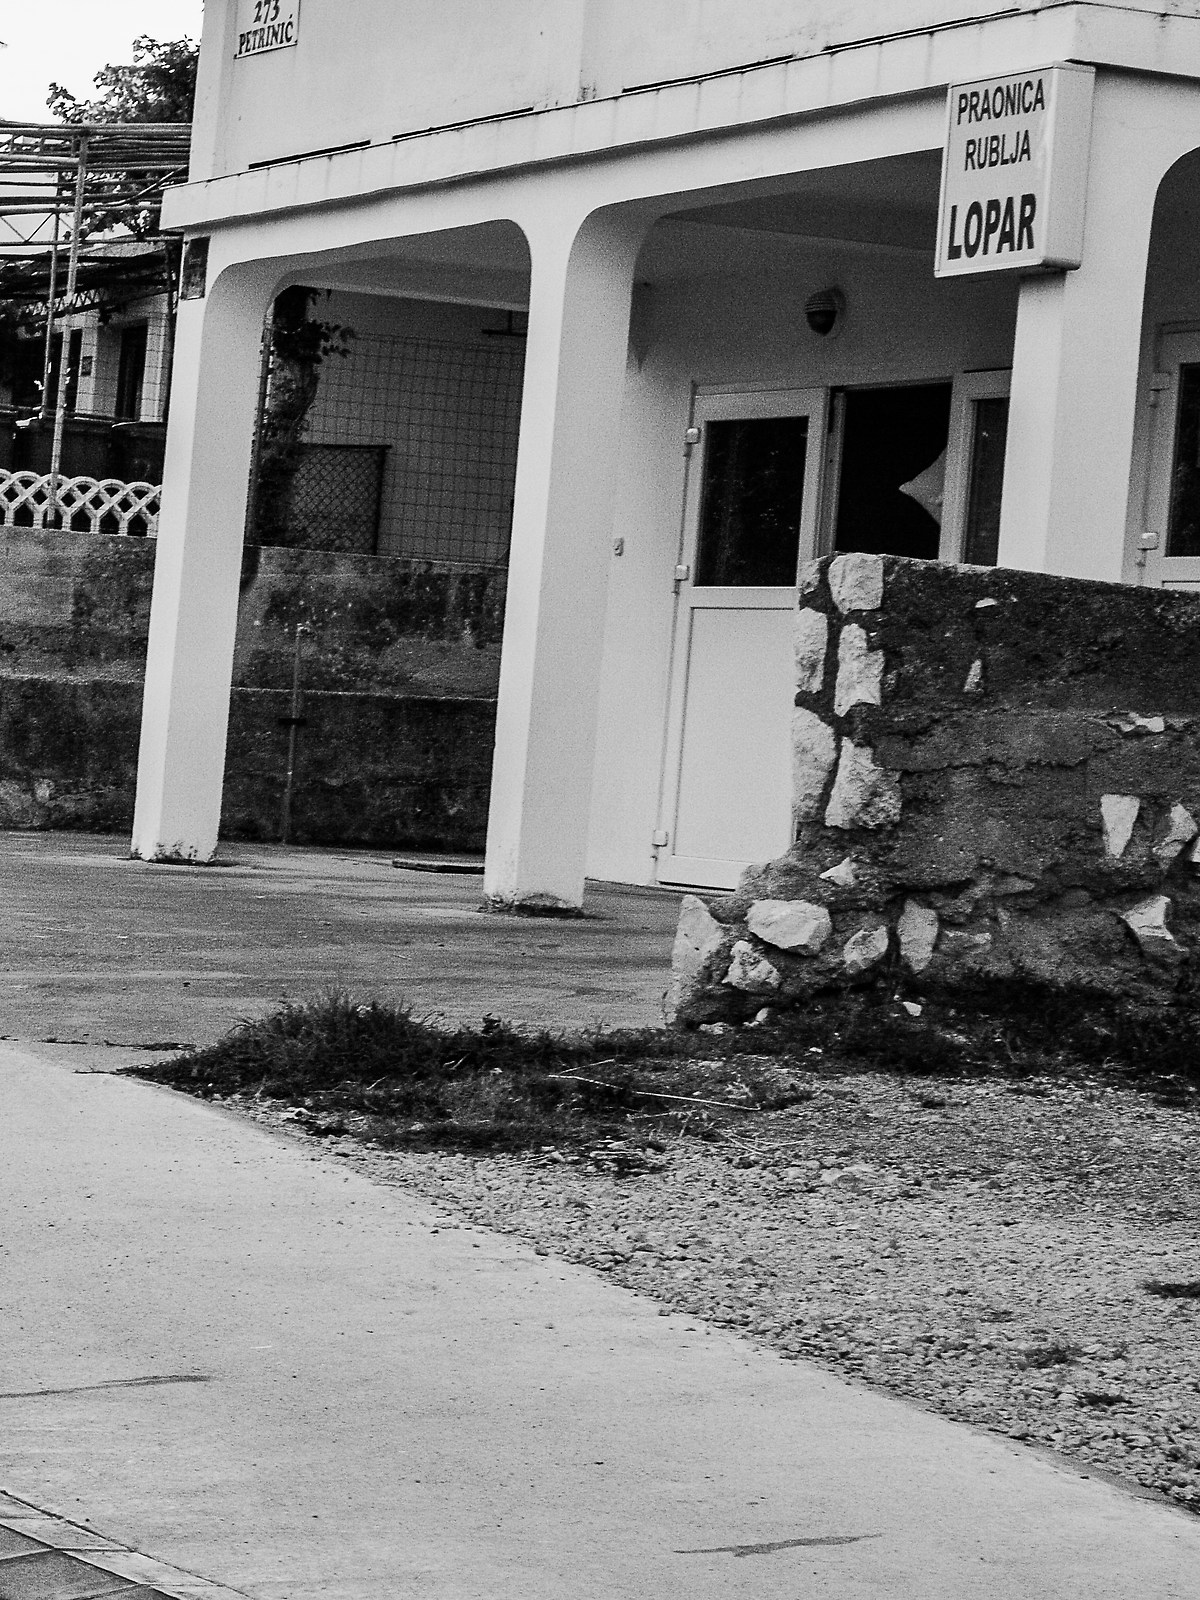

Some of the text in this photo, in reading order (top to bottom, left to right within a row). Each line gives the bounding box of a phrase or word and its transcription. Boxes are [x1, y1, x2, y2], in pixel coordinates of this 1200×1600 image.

[238, 14, 294, 55] PETRINIĆ
[957, 79, 1045, 125] PRAONICA
[964, 129, 1031, 171] RUBLJA
[947, 193, 1036, 260] LOPAR
